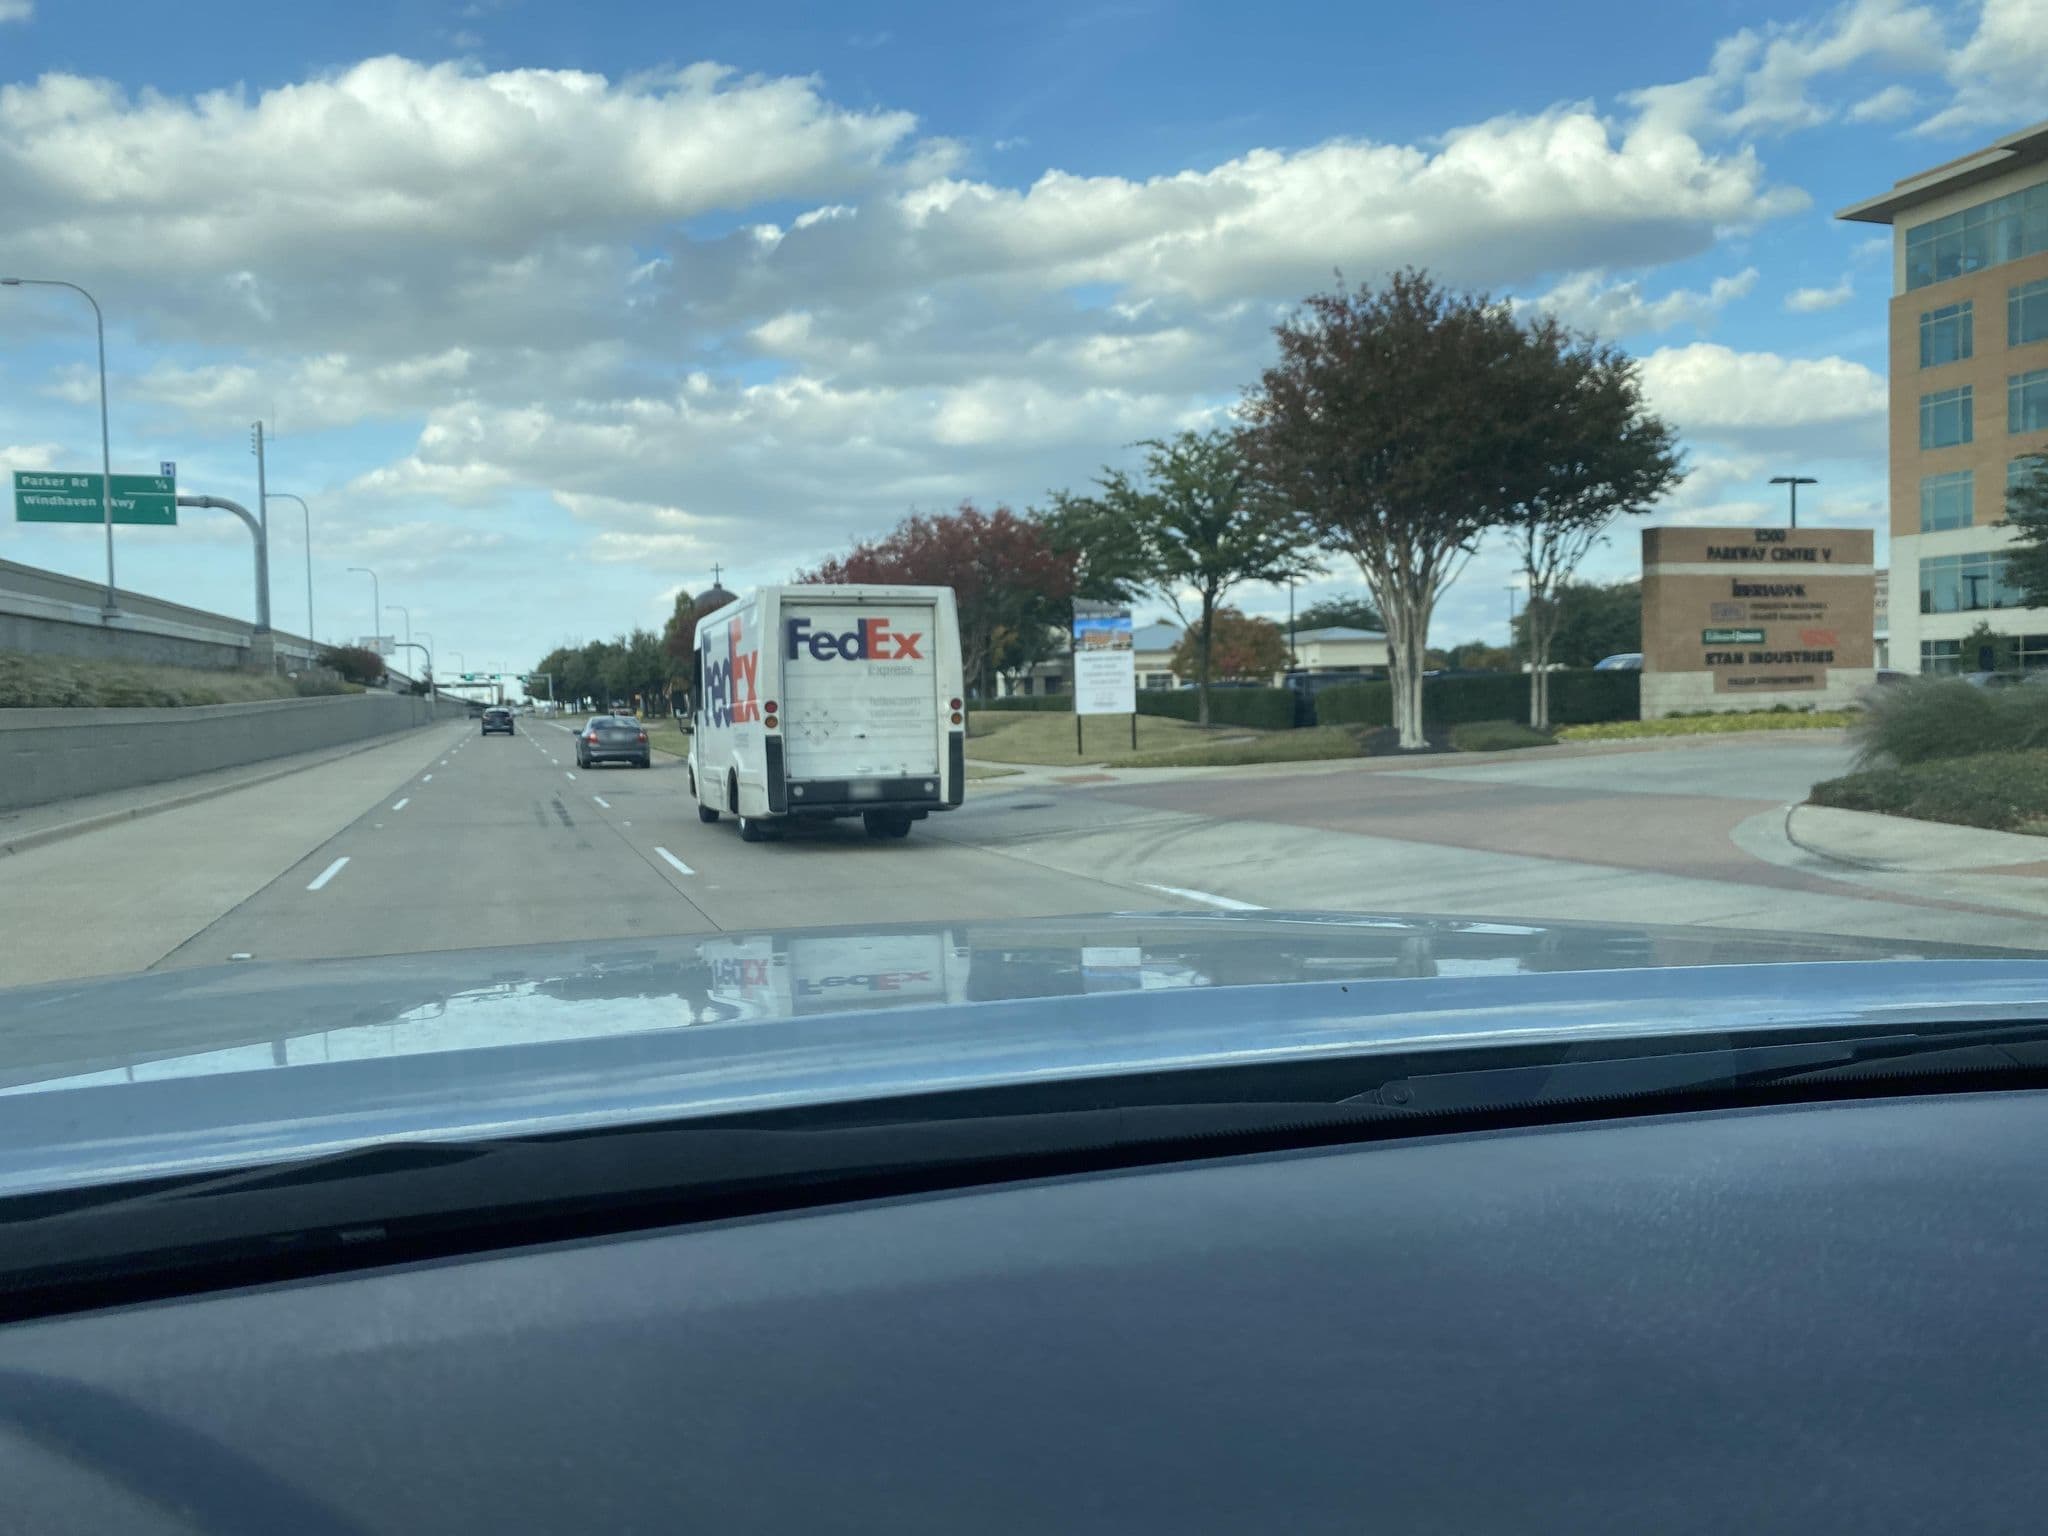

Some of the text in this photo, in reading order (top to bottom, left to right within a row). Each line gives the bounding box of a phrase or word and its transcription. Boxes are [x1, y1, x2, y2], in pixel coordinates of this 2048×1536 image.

[21, 475, 89, 488] Parker Rd
[23, 495, 136, 510] Windhaven kwy
[1706, 546, 1766, 561] PARKWAY
[1771, 547, 1818, 562] CENTRE
[788, 617, 924, 661] FedEx
[1749, 650, 1834, 665] INDUSTRIES
[703, 614, 762, 729] FedEx
[867, 664, 914, 677] Express
